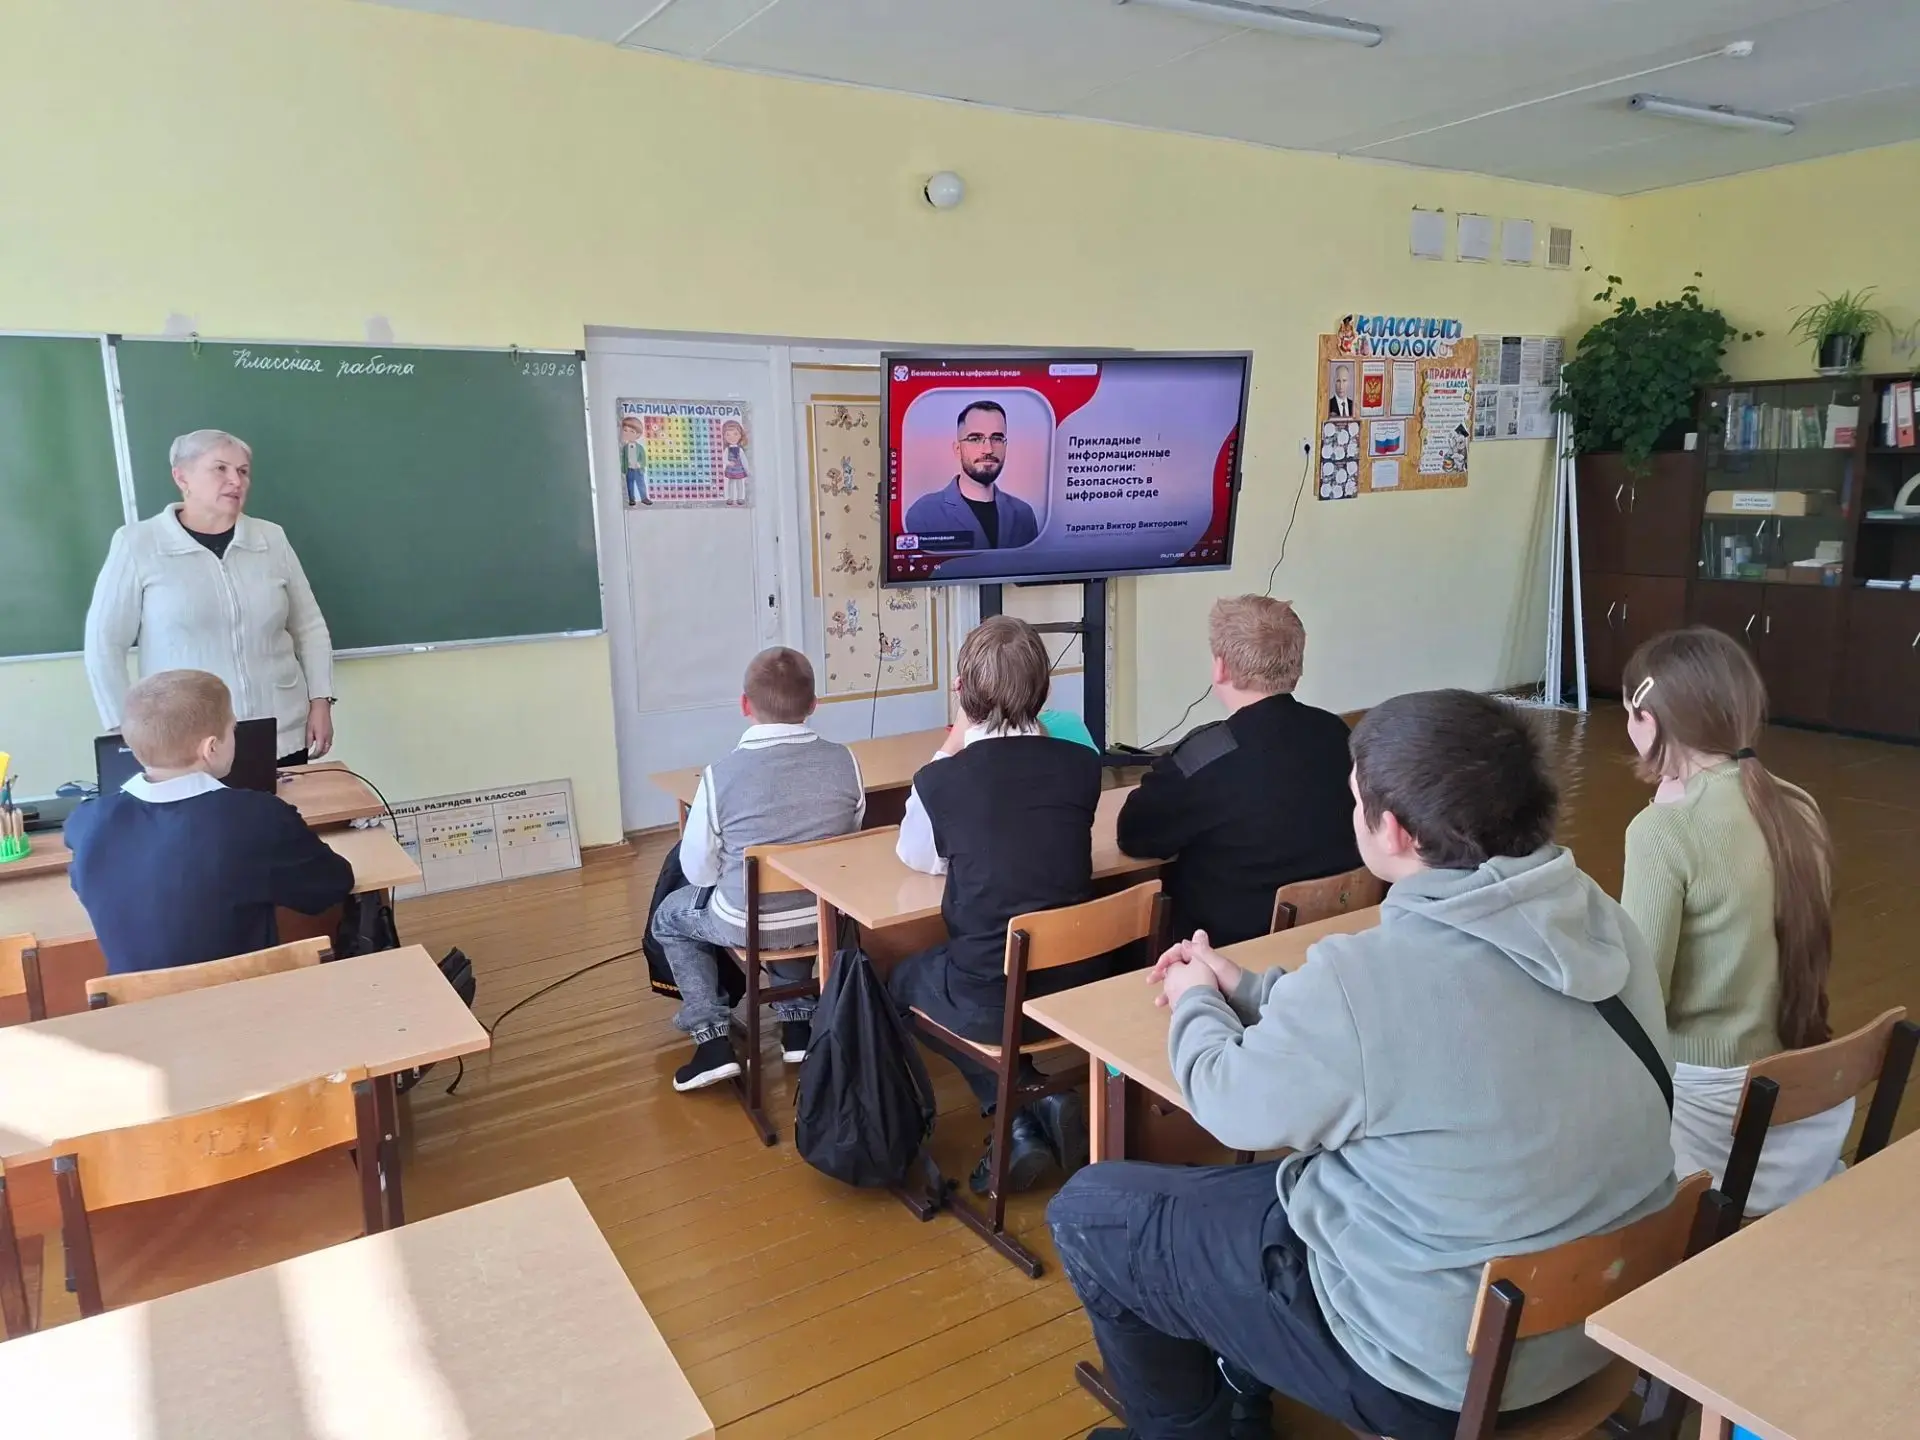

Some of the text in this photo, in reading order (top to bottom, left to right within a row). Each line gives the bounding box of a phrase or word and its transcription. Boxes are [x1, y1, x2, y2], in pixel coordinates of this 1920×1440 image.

[1356, 315, 1462, 339] КЛАССНЫЙ
[1370, 338, 1437, 357] УГОЛОК
[232, 349, 416, 379] Классная работа
[911, 369, 960, 377] Безопасность
[966, 369, 1000, 379] цифровой
[1429, 367, 1468, 380] ПРАВИЛА
[1446, 381, 1469, 389] КЛАССА
[622, 403, 741, 417] ТАБЛИЦА ПИФАГОРА
[1068, 436, 1142, 448] Прикладные
[1067, 449, 1171, 462] информационные
[1067, 463, 1136, 474] технологии:
[1066, 476, 1153, 487] Безопасность в
[1065, 489, 1159, 502] цифровой среде
[1065, 519, 1189, 532] Тарапата Виктор Викторович
[424, 798, 472, 811] РАЗРЯДОВ
[484, 789, 527, 801] КЛАССОВ
